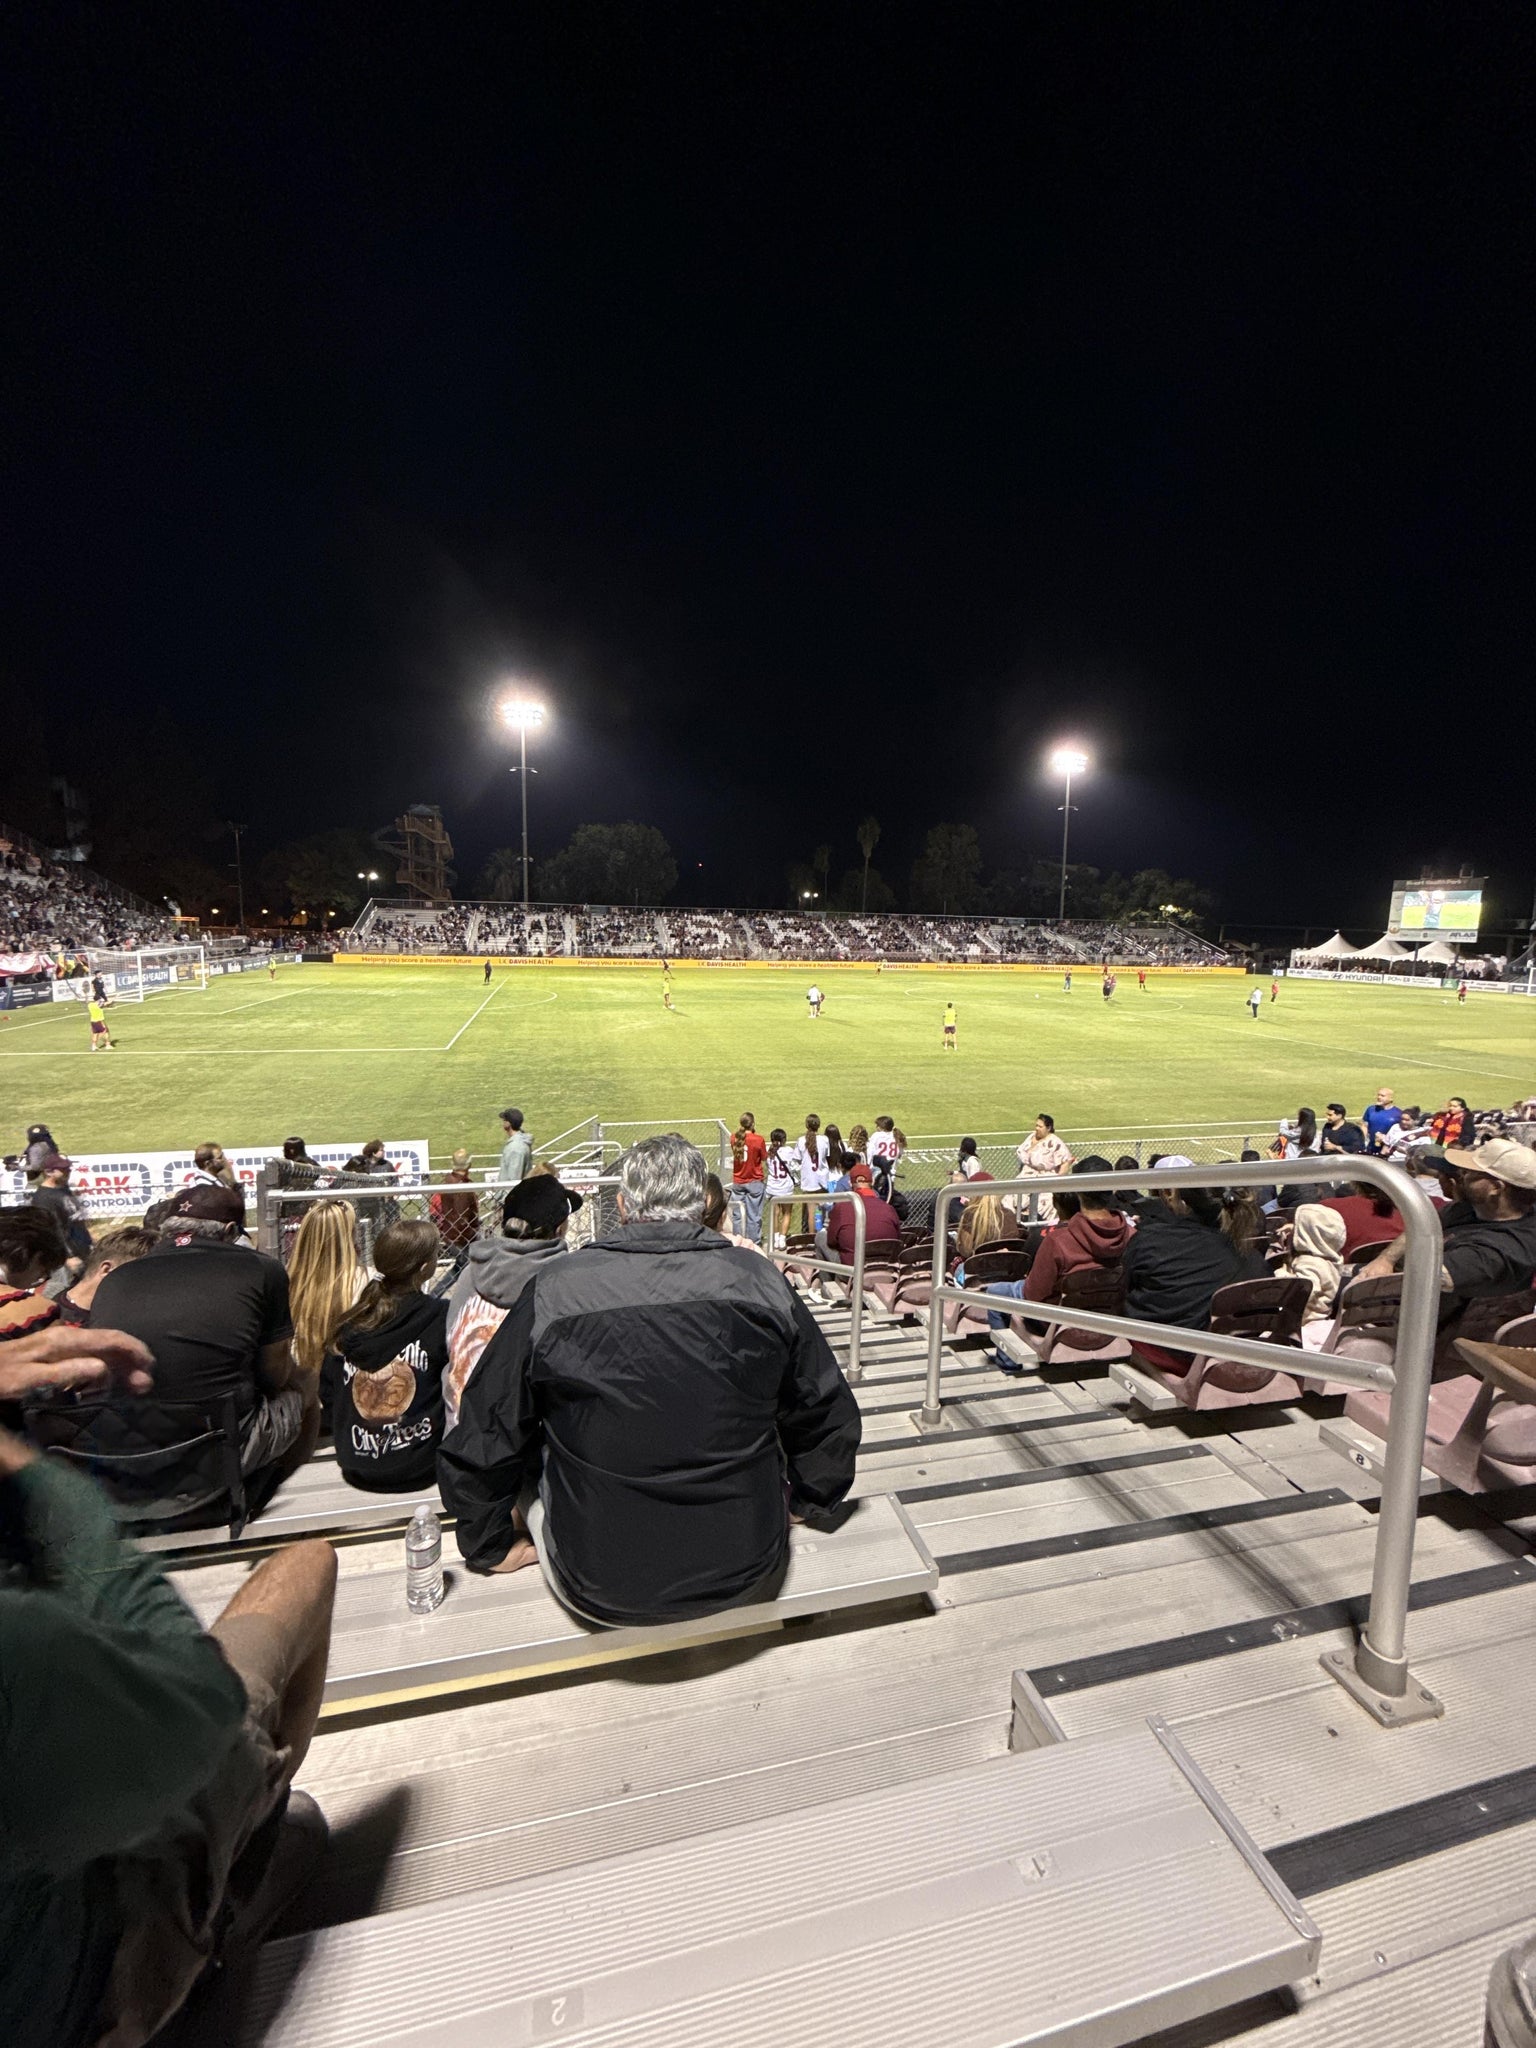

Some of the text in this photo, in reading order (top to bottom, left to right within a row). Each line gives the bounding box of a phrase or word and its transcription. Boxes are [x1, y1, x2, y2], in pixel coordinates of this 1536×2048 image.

[361, 956, 387, 965] Helping
[1345, 974, 1381, 983] HYUNDAI
[878, 1141, 897, 1158] 28
[75, 1175, 132, 1196] ARK
[80, 1198, 131, 1208] ONTROL
[351, 1424, 379, 1459] City
[383, 1417, 432, 1446] Trees
[551, 1996, 567, 2027] 2
